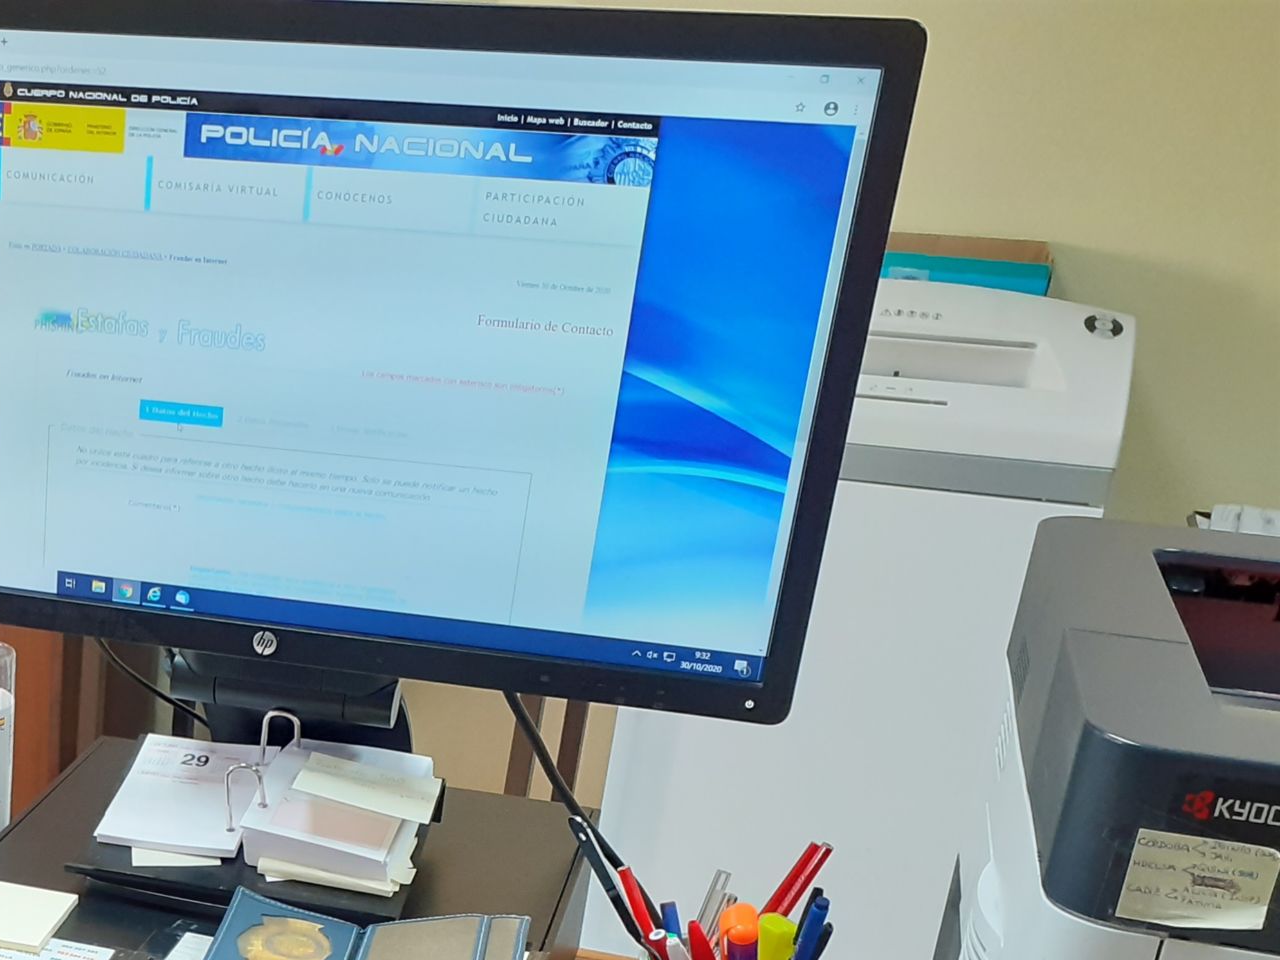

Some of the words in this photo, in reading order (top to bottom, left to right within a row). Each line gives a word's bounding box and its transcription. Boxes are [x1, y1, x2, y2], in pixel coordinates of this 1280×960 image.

[16, 88, 65, 98] CUERPO
[69, 90, 127, 102] NACIONAL
[131, 94, 148, 103] DE
[497, 113, 519, 122] Inicio
[526, 115, 547, 125] Mapa
[548, 117, 565, 126] web
[573, 118, 609, 128] Buscador
[617, 120, 653, 130] Contacto
[200, 124, 334, 152] POLICÍA
[354, 133, 533, 164] NACIONAL
[6, 169, 95, 185] COMUNICACIÓN
[228, 184, 279, 198] VIRTUAL
[485, 191, 585, 207] PARTICIPACIÓN
[483, 212, 558, 227] CIUDADANA
[77, 307, 150, 338] Estafas
[159, 328, 168, 343] y
[177, 319, 266, 351] Fraudes
[477, 314, 542, 331] Formulario
[544, 320, 558, 332] de
[561, 322, 614, 337] Contacto
[111, 374, 143, 384] Internet
[177, 408, 191, 418] del
[253, 630, 278, 656] hp
[694, 651, 711, 660] 9:32
[680, 660, 723, 673] 30/10/2020
[179, 753, 211, 768] 29
[1213, 796, 1280, 827] KYOC
